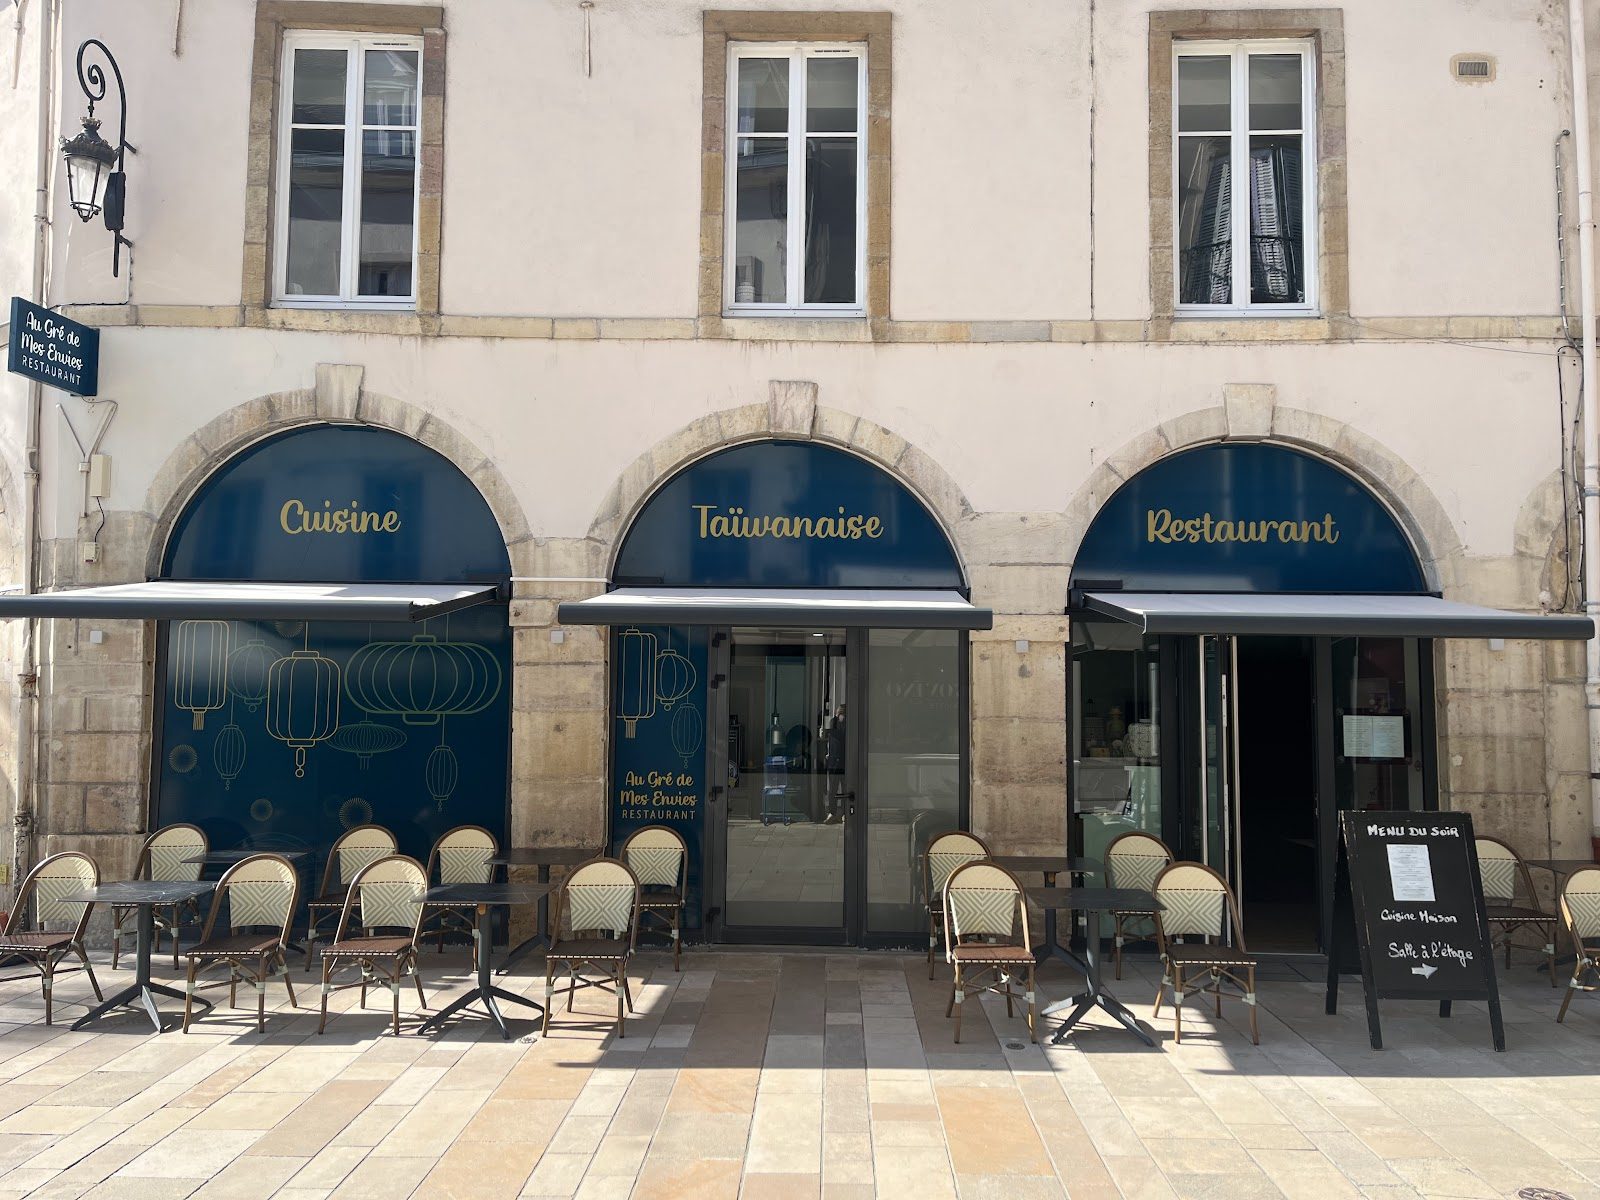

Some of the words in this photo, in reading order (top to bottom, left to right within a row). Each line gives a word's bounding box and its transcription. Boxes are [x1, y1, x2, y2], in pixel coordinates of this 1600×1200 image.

[26, 311, 42, 331] Au
[44, 319, 65, 341] Gré
[67, 331, 80, 347] de
[21, 332, 45, 357] Mes
[47, 343, 83, 370] Envies
[22, 355, 81, 385] RESTAURANT
[280, 499, 401, 534] Cuisine
[692, 505, 884, 539] Taïwanaise
[1147, 509, 1339, 544] Restaurant
[625, 770, 645, 787] Au
[647, 771, 674, 788] Gré
[676, 773, 694, 787] de
[620, 790, 650, 806] Mes
[652, 790, 698, 807] Envies
[622, 809, 696, 820] RESTAURANT
[1367, 824, 1405, 837] MENU
[1408, 826, 1428, 837] DU
[1380, 908, 1417, 923] Cuisine
[1419, 910, 1458, 924] Maison
[1388, 942, 1419, 959] Salle
[1421, 944, 1431, 959] à
